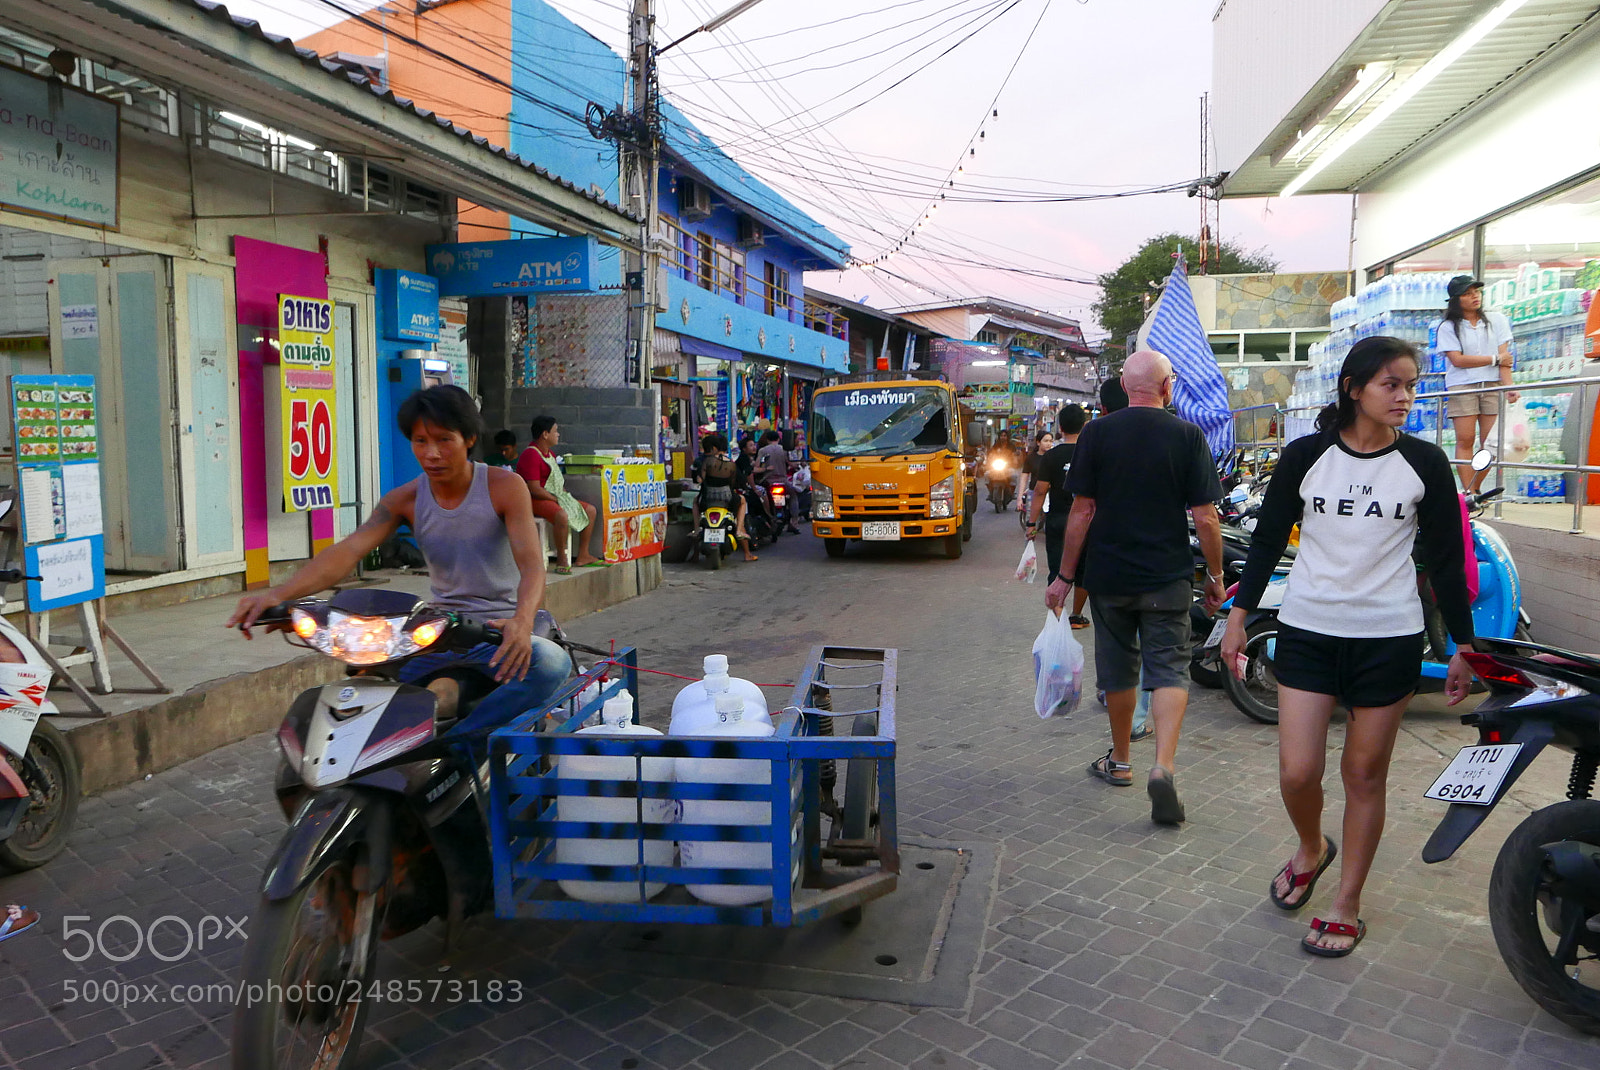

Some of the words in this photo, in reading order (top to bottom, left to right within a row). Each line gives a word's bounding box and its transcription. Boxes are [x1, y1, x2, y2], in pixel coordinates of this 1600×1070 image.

[18, 148, 100, 185] เกาะล้าน
[16, 179, 110, 214] Kohlarn
[458, 263, 479, 271] KTB
[518, 261, 562, 279] ATM
[283, 299, 331, 333] อาหาร
[411, 313, 430, 326] ATM
[283, 337, 331, 369] ตามสั่ง
[844, 389, 915, 406] เมืองพัทยา
[290, 399, 332, 478] 50
[291, 484, 333, 508] บาท
[604, 467, 668, 514] โรตีเกาะล้าน
[1348, 484, 1373, 496] I'M
[1312, 496, 1406, 520] REAL
[863, 526, 898, 536] 85-8006
[1438, 784, 1486, 800] 6904
